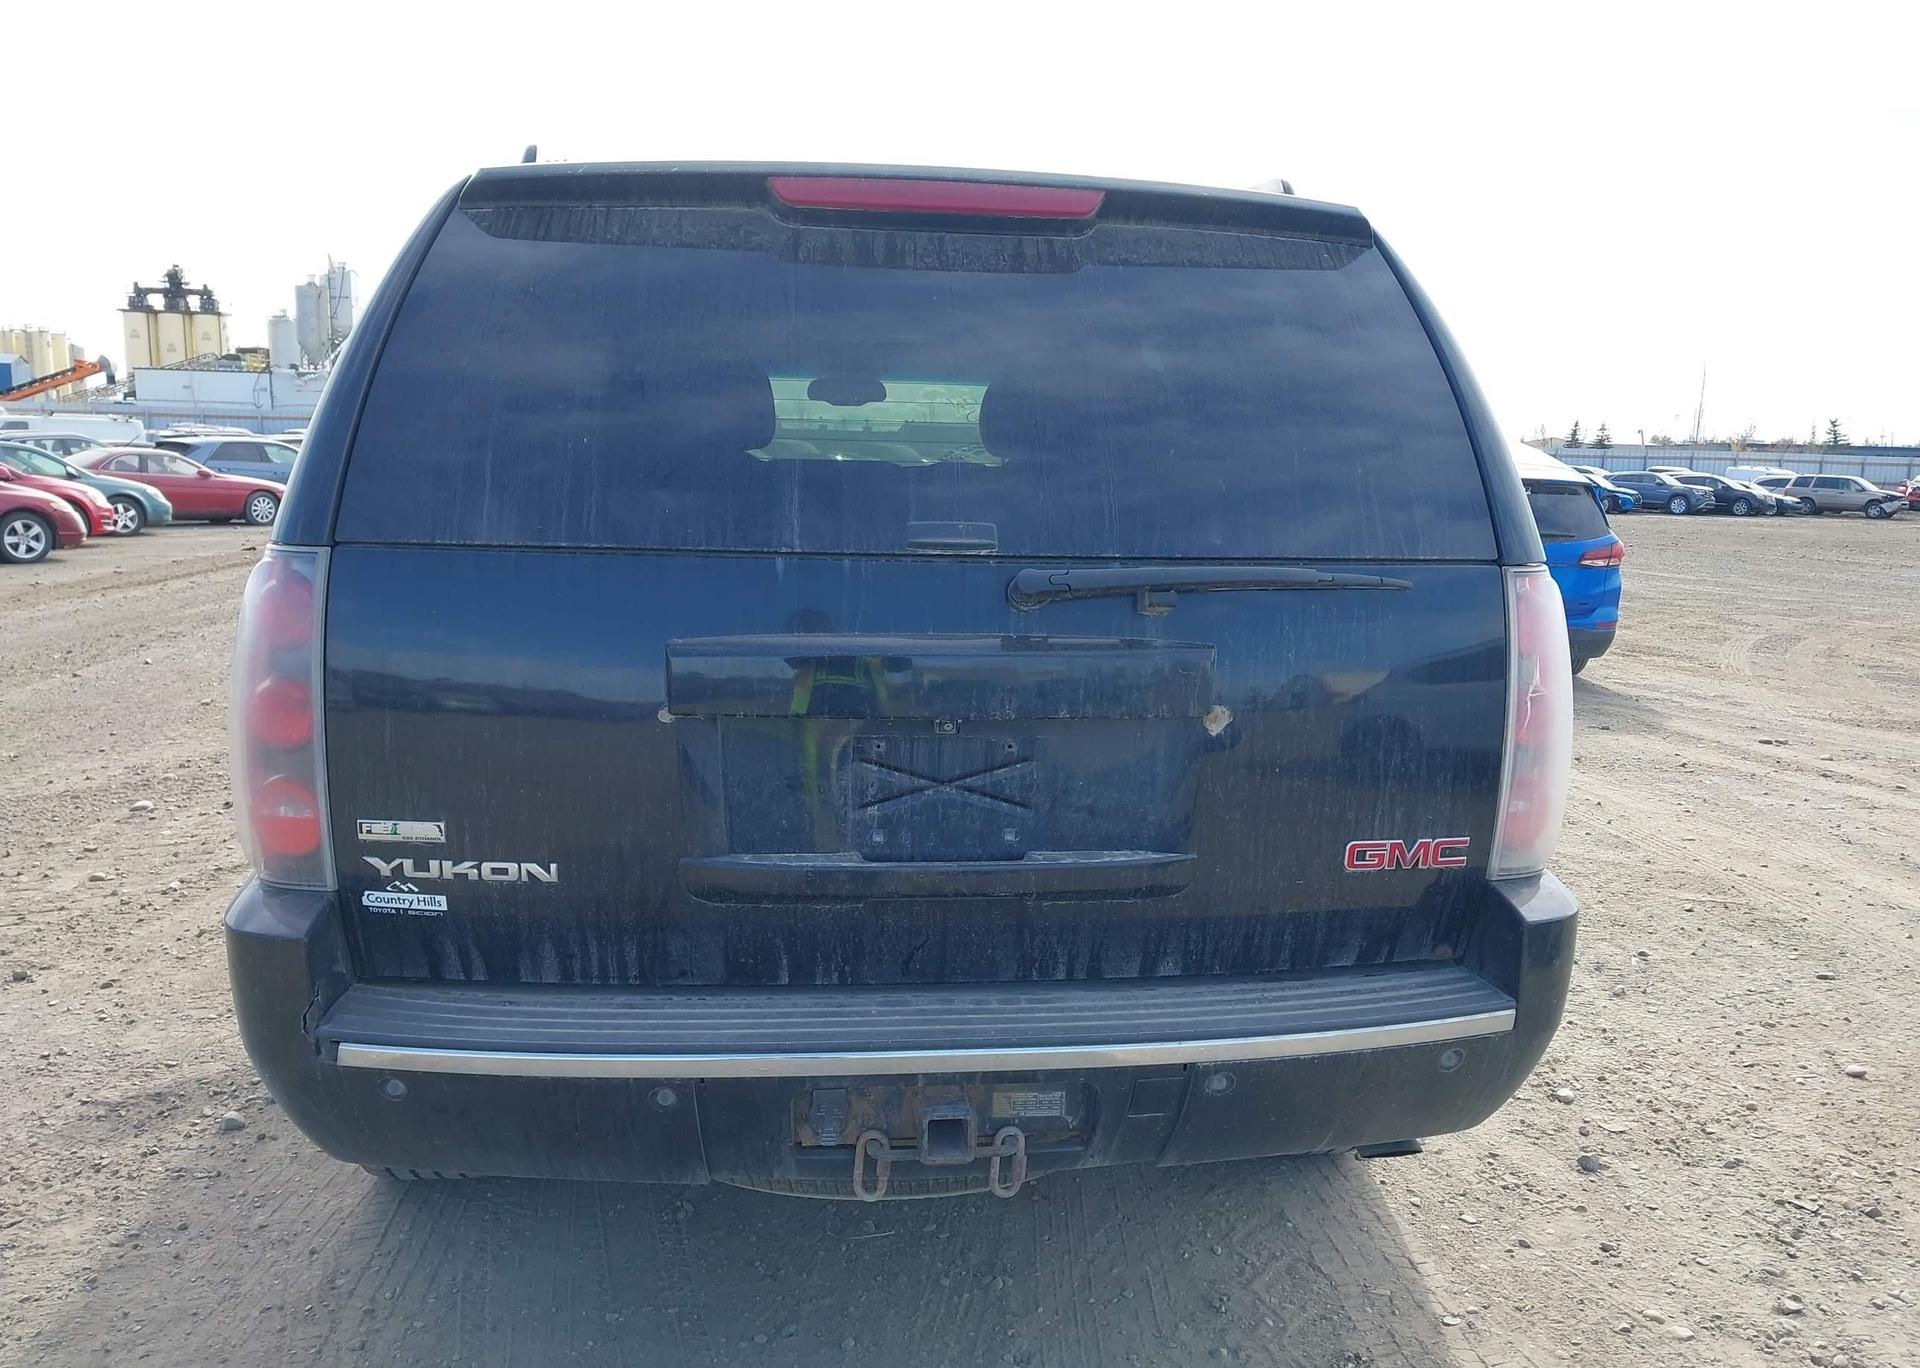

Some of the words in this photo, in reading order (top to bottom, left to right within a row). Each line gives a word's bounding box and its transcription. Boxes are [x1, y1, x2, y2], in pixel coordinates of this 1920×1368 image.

[1344, 837, 1470, 871] GMC
[362, 856, 559, 883] YUKON
[366, 893, 414, 908] Country
[416, 896, 442, 908] Hills
